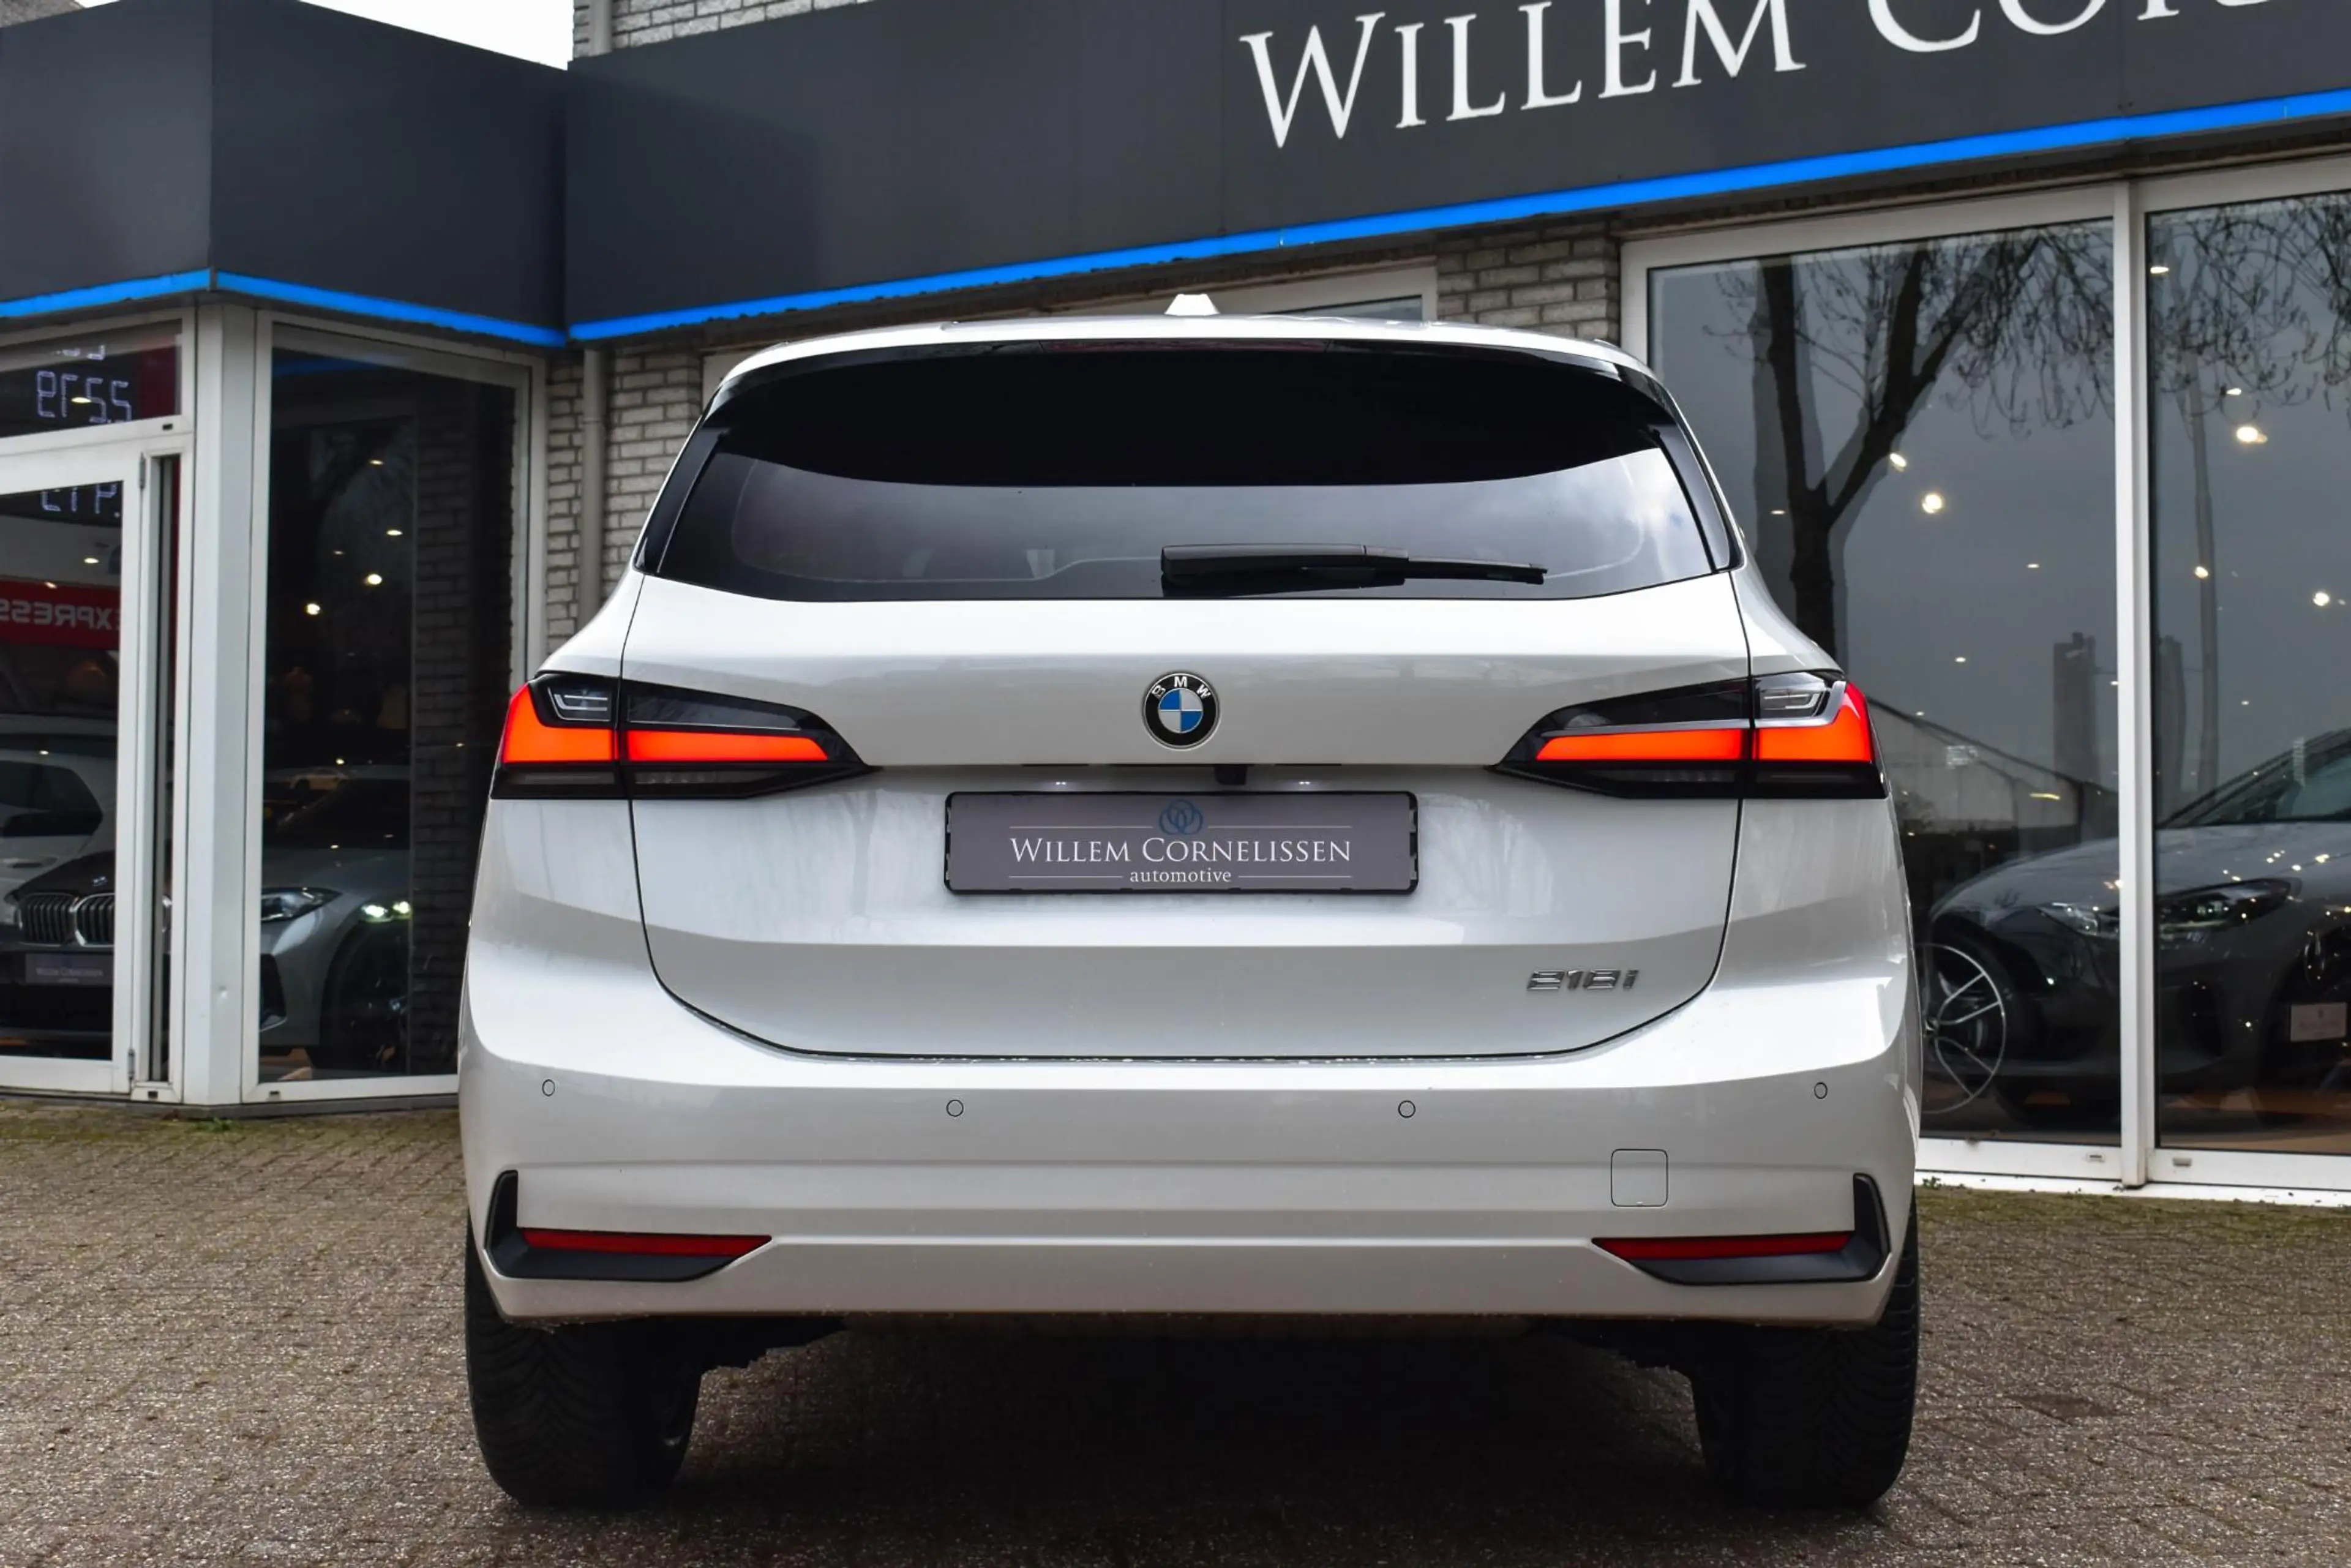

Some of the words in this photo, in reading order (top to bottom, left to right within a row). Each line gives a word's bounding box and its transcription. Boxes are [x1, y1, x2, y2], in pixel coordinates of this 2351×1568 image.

[1239, 0, 1806, 148] WILLEM
[1152, 676, 1211, 700] BMW
[1010, 838, 1131, 863] WILLEM
[1142, 838, 1351, 863] CORNELISSEN
[1130, 867, 1232, 883] automotive
